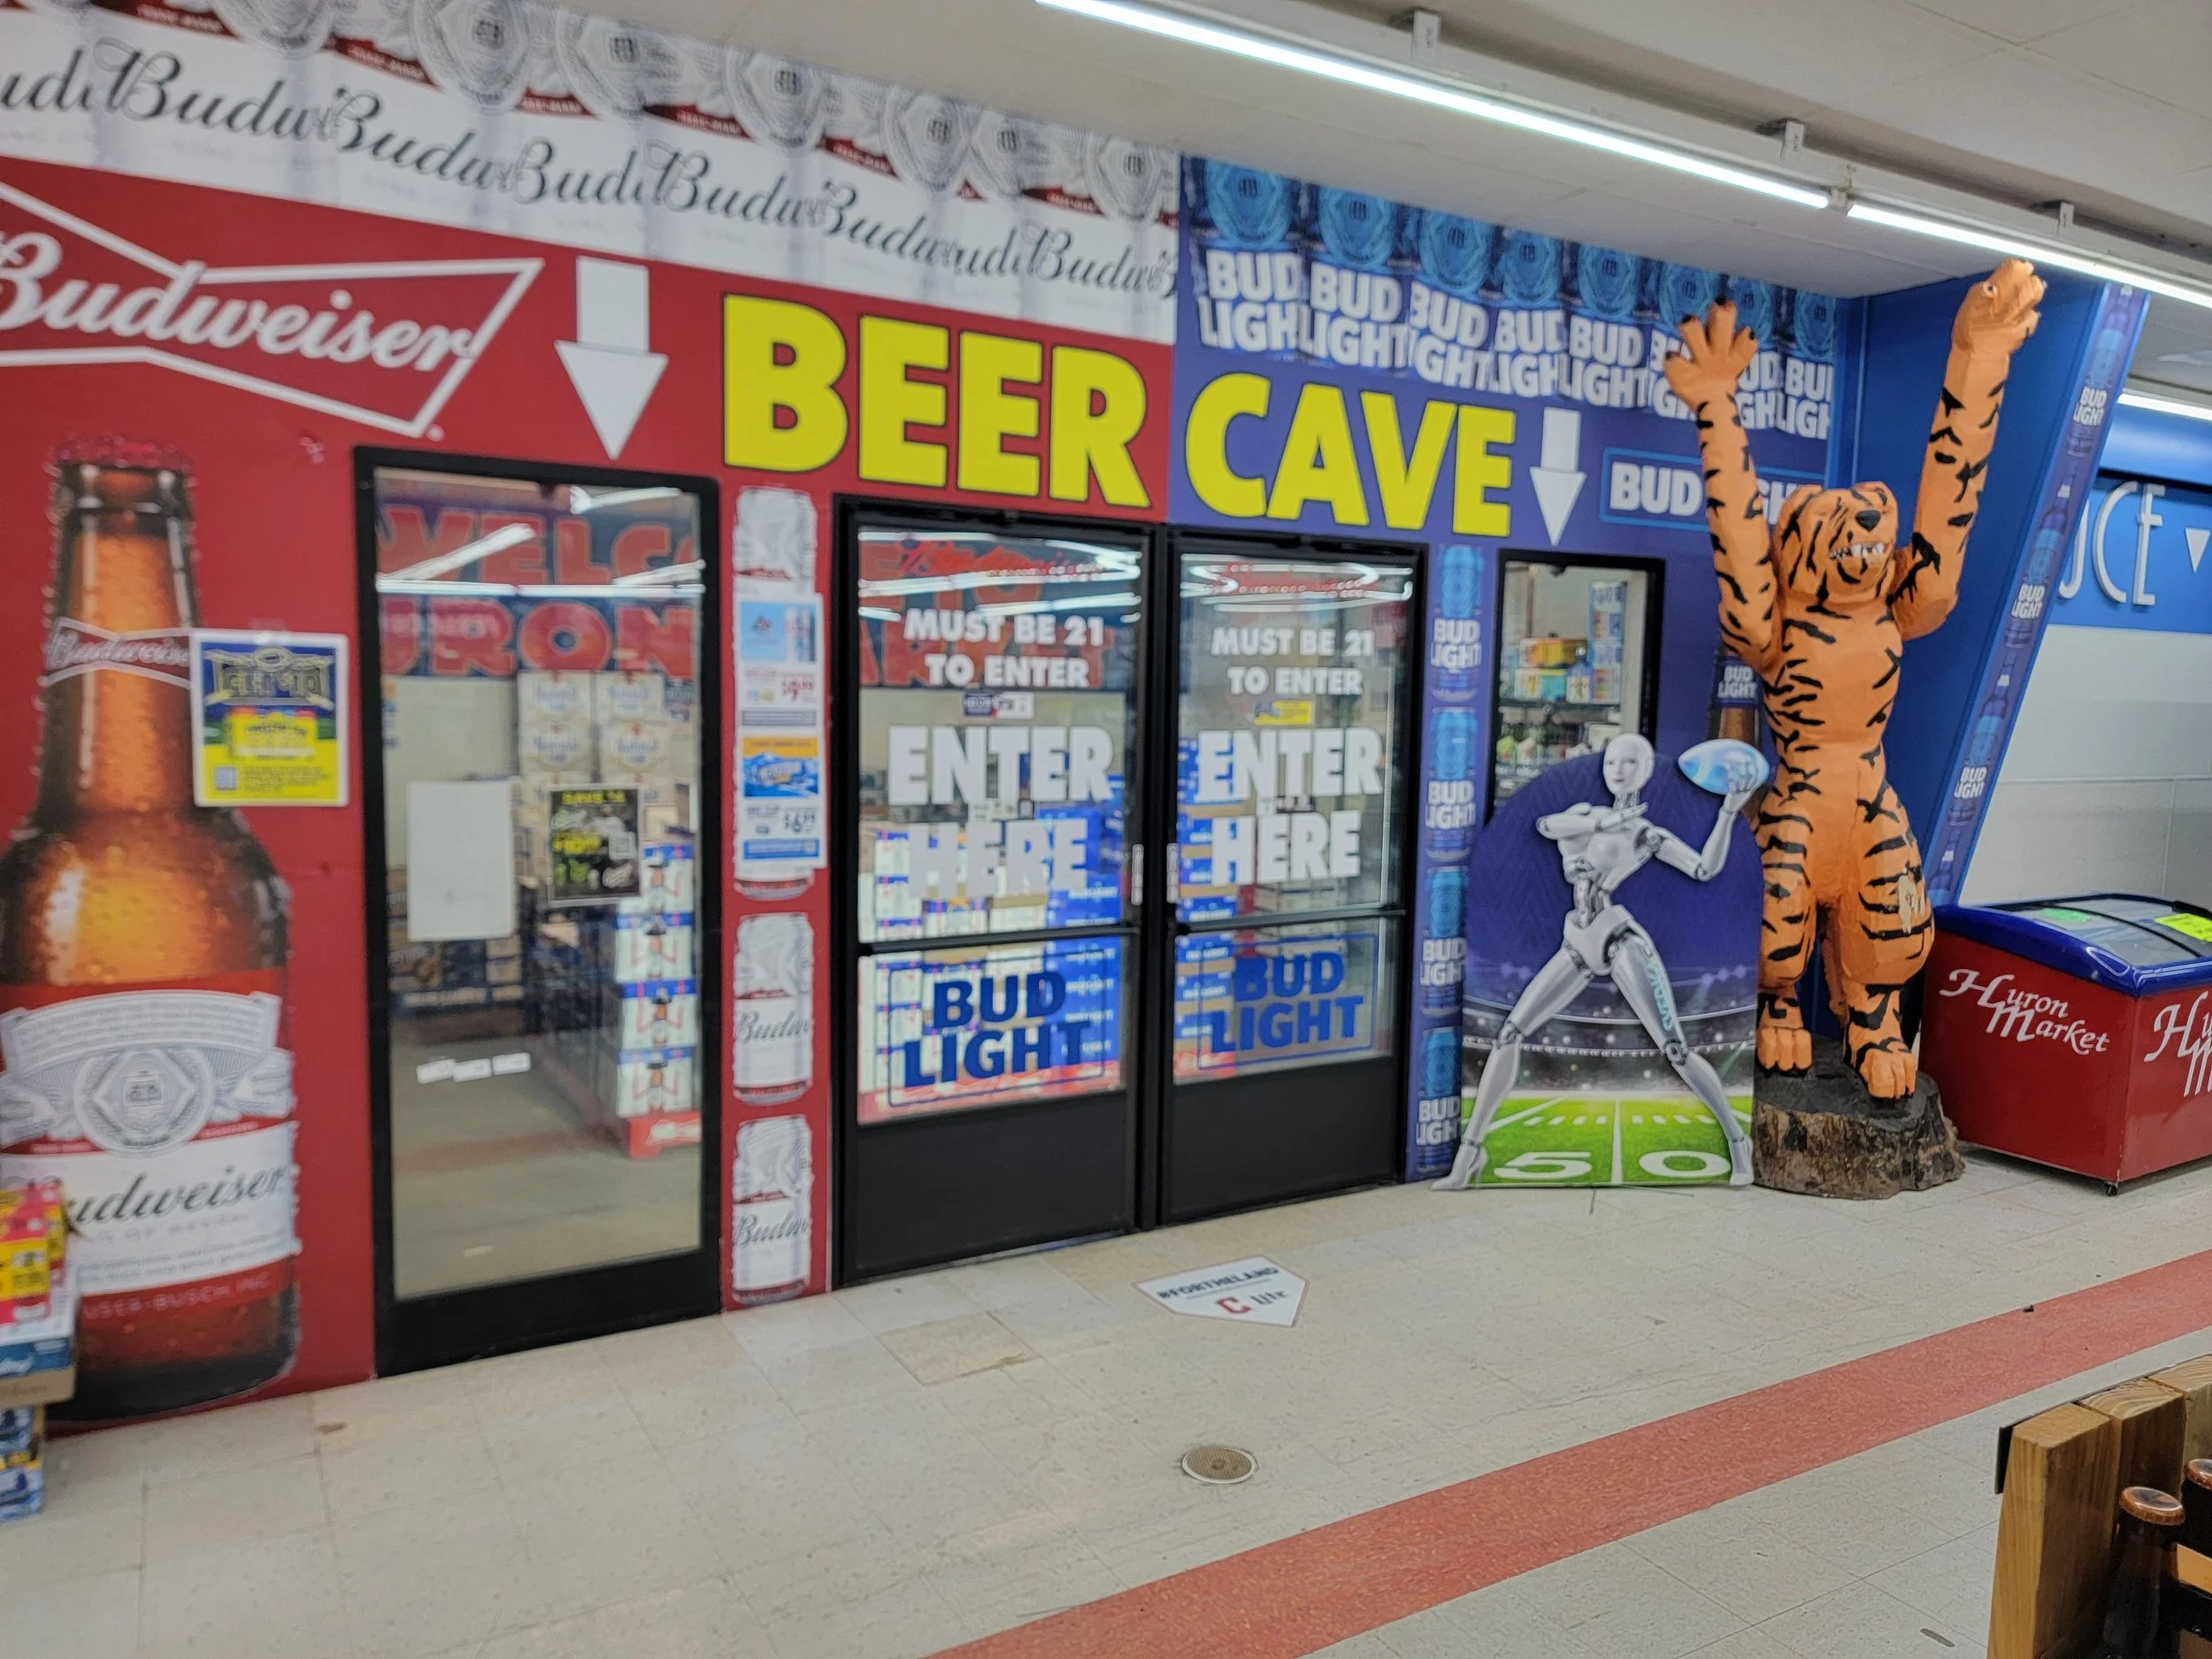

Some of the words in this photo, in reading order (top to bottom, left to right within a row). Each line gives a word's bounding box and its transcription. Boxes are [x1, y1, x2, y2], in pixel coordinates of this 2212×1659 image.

[1206, 249, 1302, 302] BUD
[1310, 262, 1402, 322] BUD
[0, 232, 475, 373] Budweiser
[1569, 315, 1645, 367] BUD
[1740, 351, 1782, 392] UD
[723, 293, 1151, 509] BEER
[1184, 372, 1517, 537] CAVE
[2079, 388, 2107, 408] BUD
[1609, 462, 1702, 517] BUD
[2017, 584, 2047, 603] BUD
[903, 608, 1005, 642] MUST
[1014, 614, 1056, 644] BE
[1064, 616, 1104, 647] 21
[1210, 626, 1295, 657] MUST
[1299, 628, 1336, 657] BE
[1343, 629, 1376, 657] 21
[1433, 618, 1481, 643] BUD
[924, 653, 974, 687] TO
[984, 655, 1090, 687] ENTER
[1227, 666, 1270, 695] TO
[1275, 667, 1363, 695] ENTER
[1717, 680, 1759, 699] LIGHT
[1723, 664, 1755, 683] BUD
[888, 726, 1116, 806] ENTER
[1195, 727, 1384, 803] ENTER
[1960, 766, 1987, 784] BUD
[1428, 780, 1475, 804] BUD
[908, 817, 1088, 900] HERE
[1211, 810, 1362, 887] HERE
[1422, 937, 1463, 962] BUD
[933, 972, 1066, 1029] BUD
[1234, 950, 1345, 1002] BUD
[1939, 968, 2069, 1018] Huron
[1210, 995, 1364, 1053] LIGHT
[1985, 1003, 2110, 1056] Market
[903, 1020, 1090, 1088] LIGHT
[1418, 1097, 1460, 1122] BUD
[1494, 1151, 1592, 1179] 5
[1638, 1150, 1732, 1179] 0
[68, 1164, 288, 1224] udweiser
